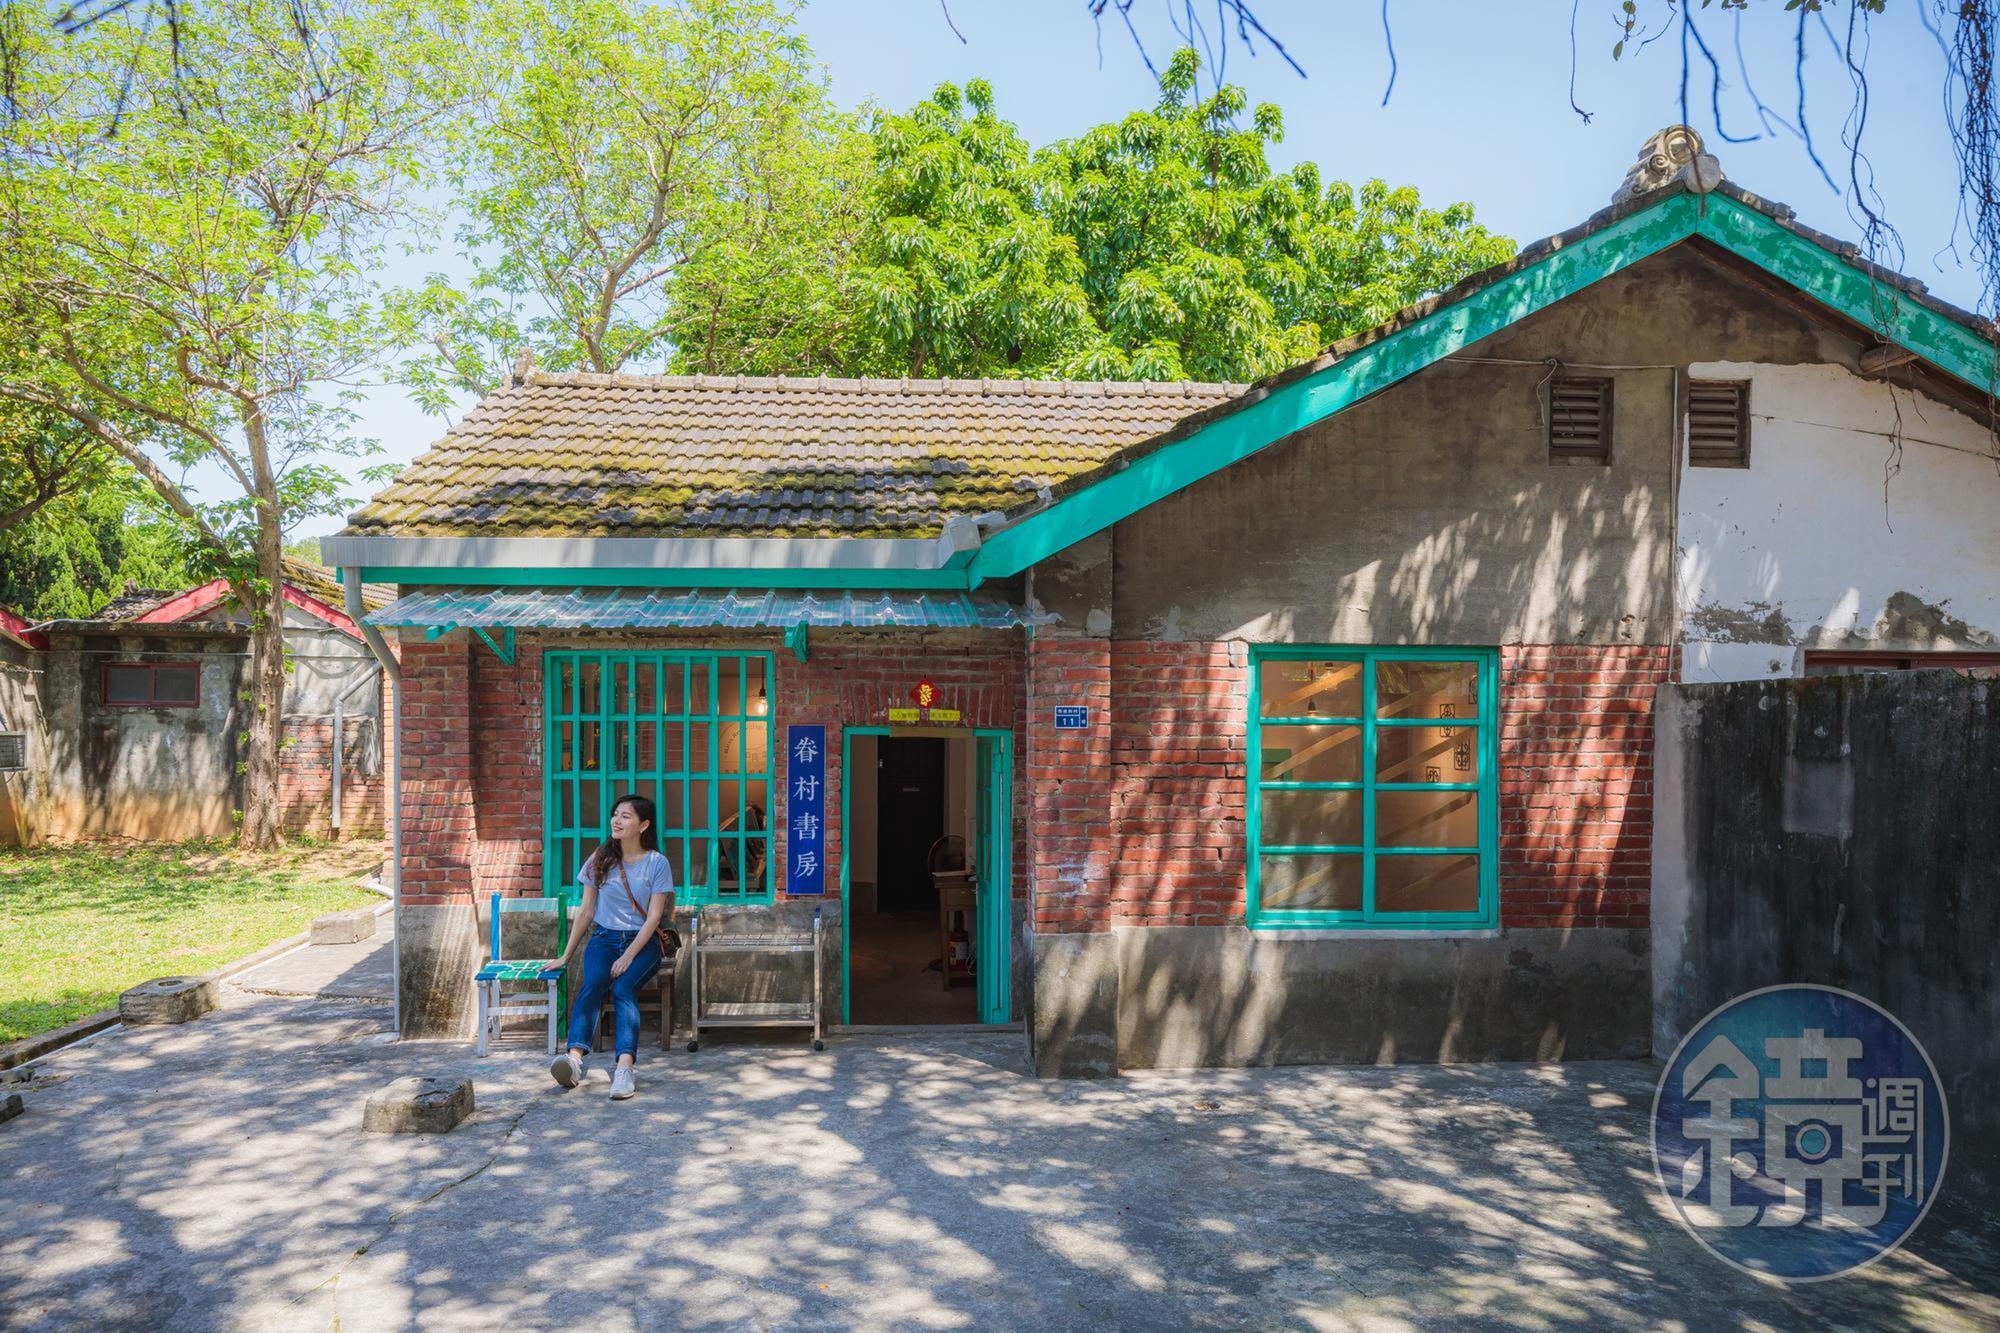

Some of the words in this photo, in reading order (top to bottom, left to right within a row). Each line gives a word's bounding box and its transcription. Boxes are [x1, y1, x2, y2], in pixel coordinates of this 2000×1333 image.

[1062, 717, 1074, 726] 11
[792, 736, 820, 878] 眷村書房
